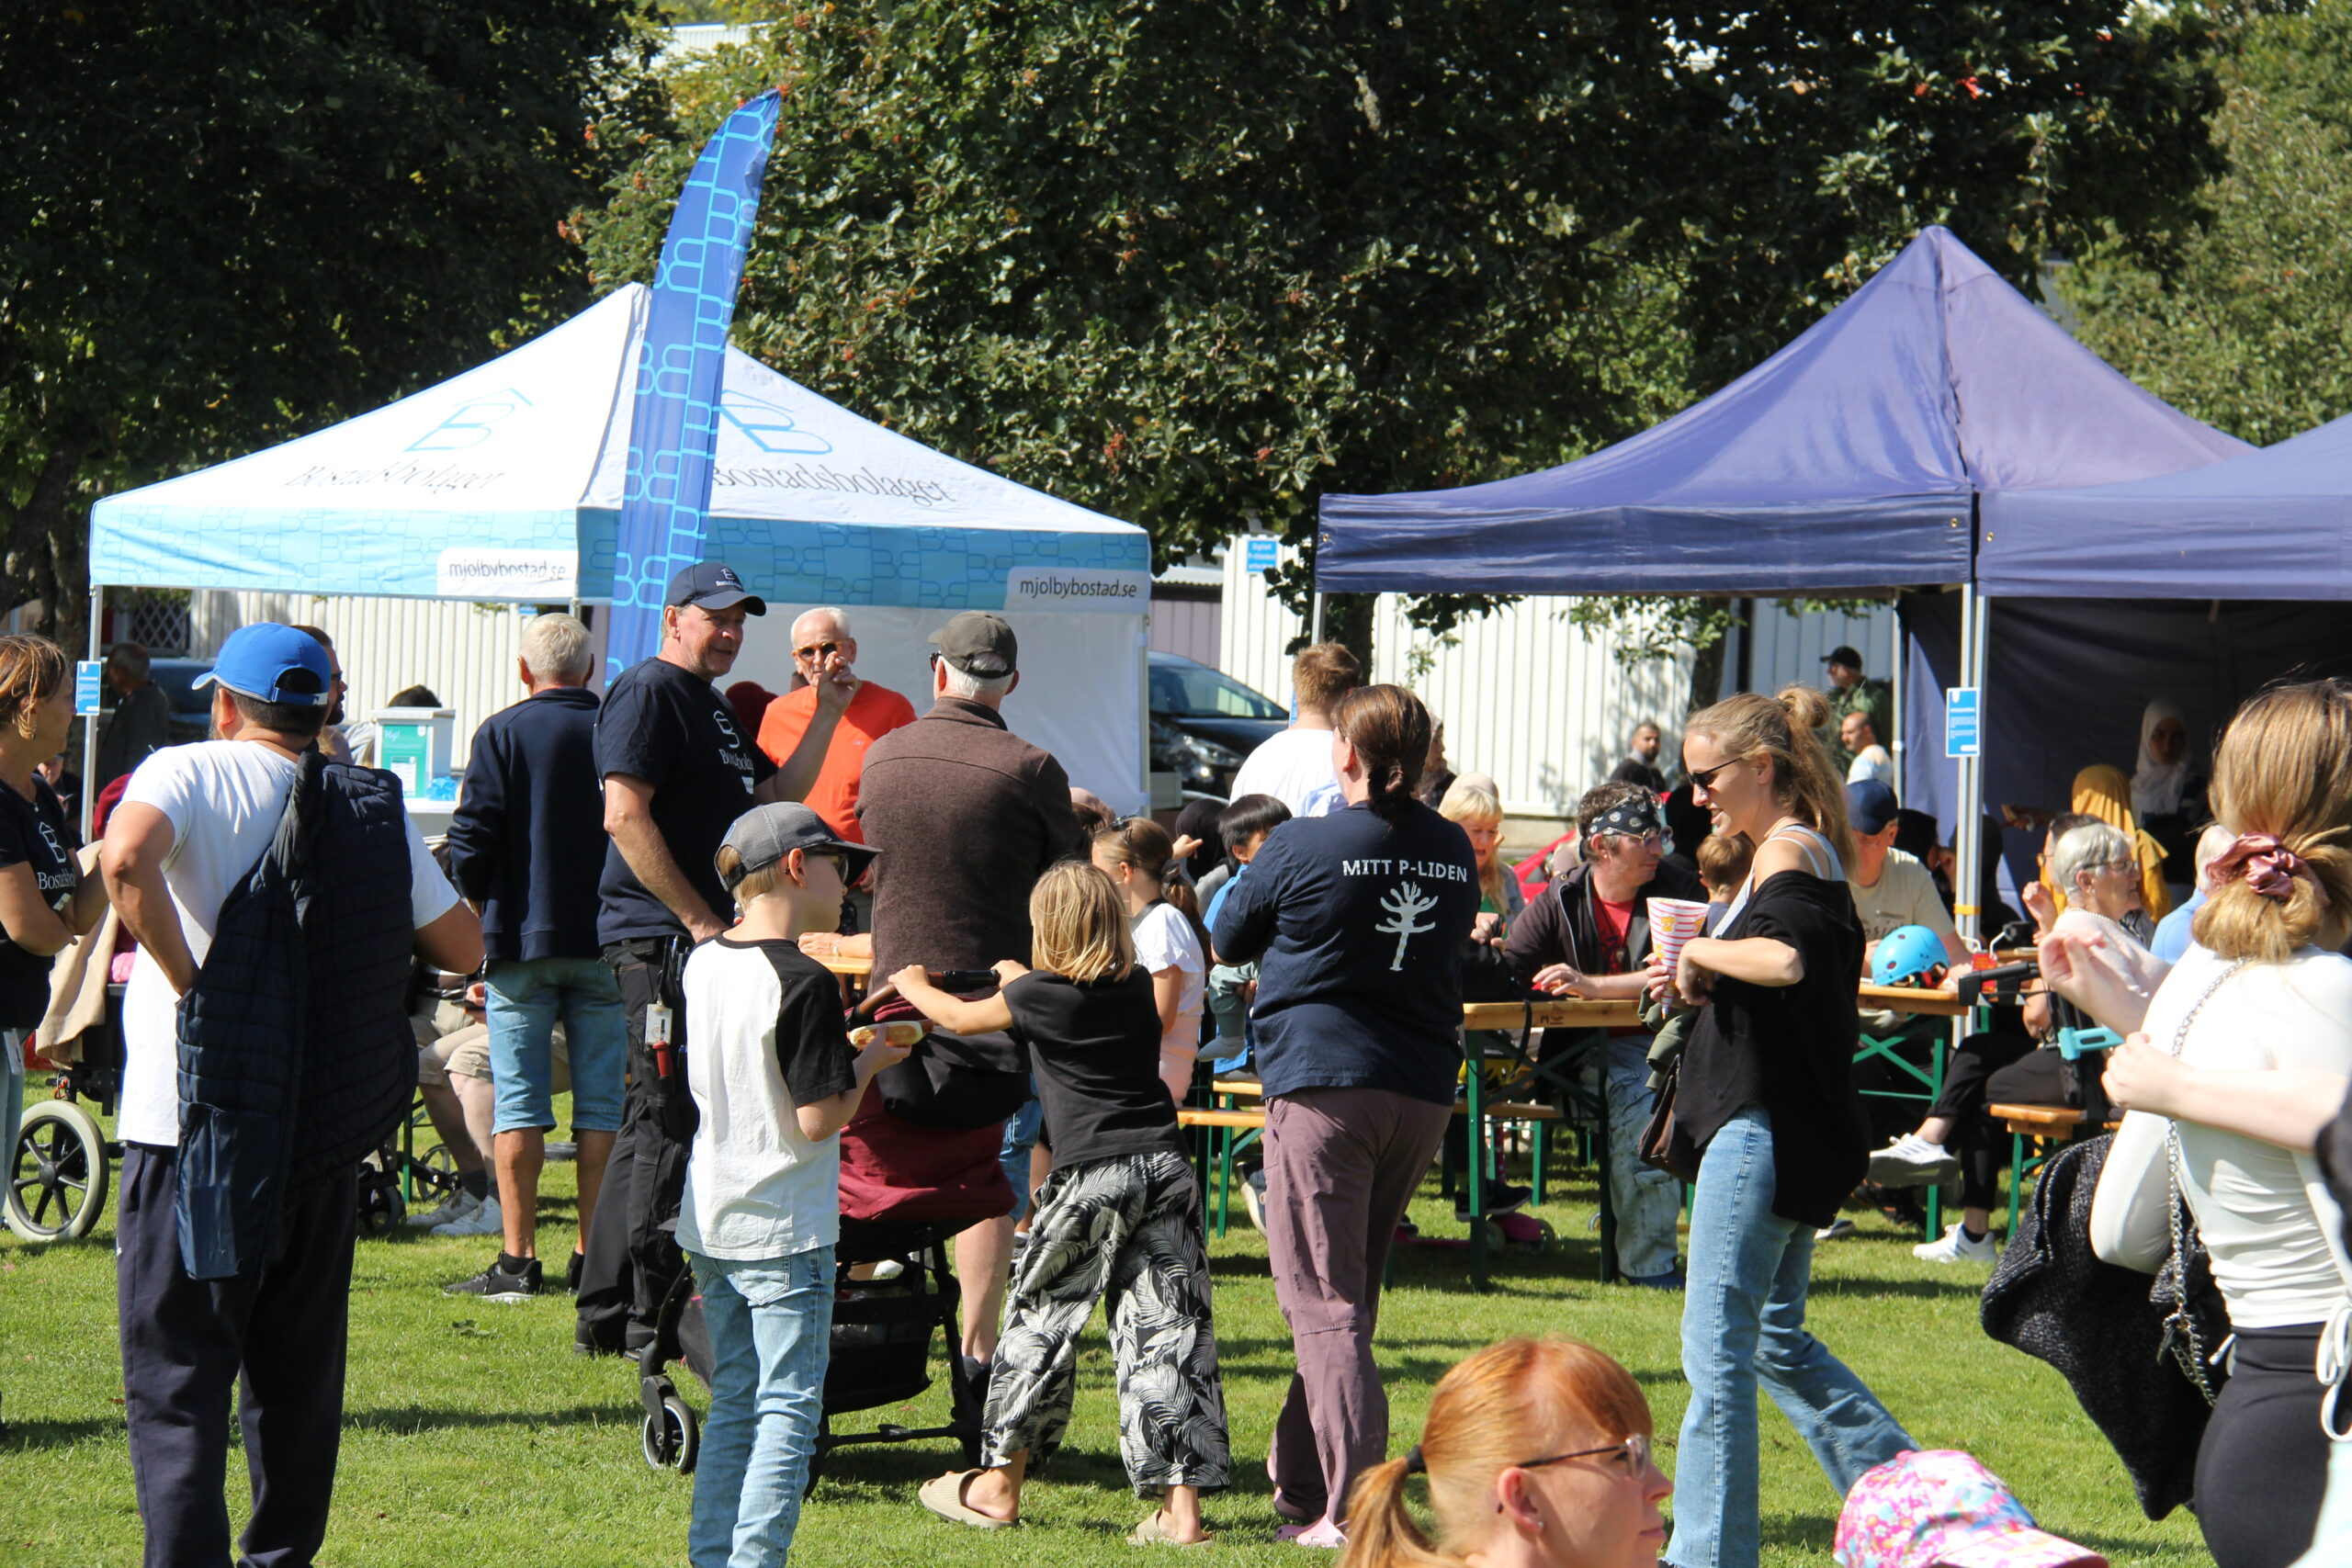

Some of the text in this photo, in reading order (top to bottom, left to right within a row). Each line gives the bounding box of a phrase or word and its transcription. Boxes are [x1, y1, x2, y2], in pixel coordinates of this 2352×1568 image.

[712, 463, 956, 506] Bostadsbolaget
[1020, 576, 1138, 599] mjolbybostad.se
[1341, 859, 1467, 882] MITT P-LIDEN
